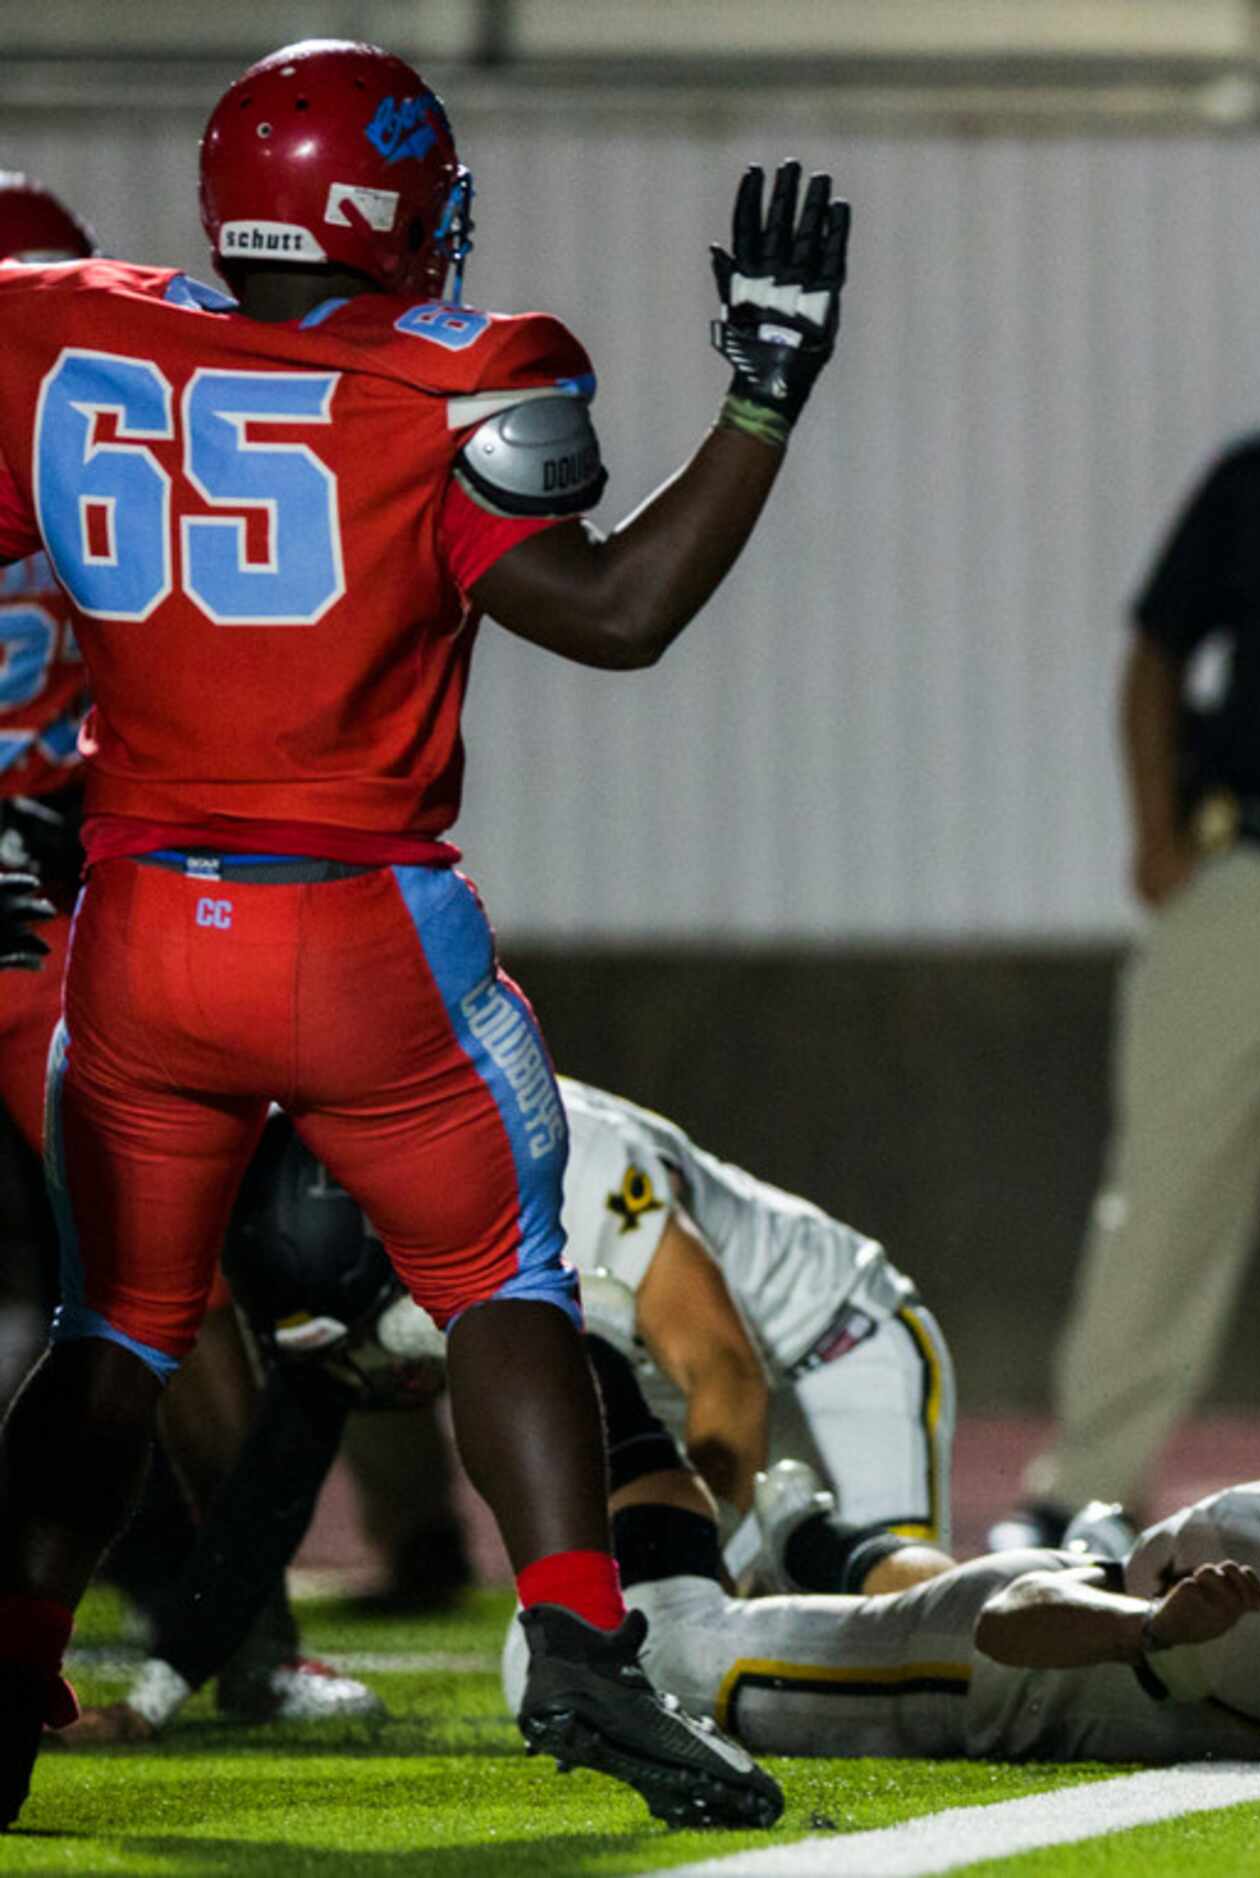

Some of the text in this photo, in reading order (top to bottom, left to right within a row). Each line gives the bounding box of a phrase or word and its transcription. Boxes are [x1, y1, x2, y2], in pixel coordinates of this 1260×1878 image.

[225, 228, 303, 251] schutt
[34, 347, 347, 626] 65
[196, 898, 233, 929] CC
[461, 976, 565, 1159] COWBOYS
